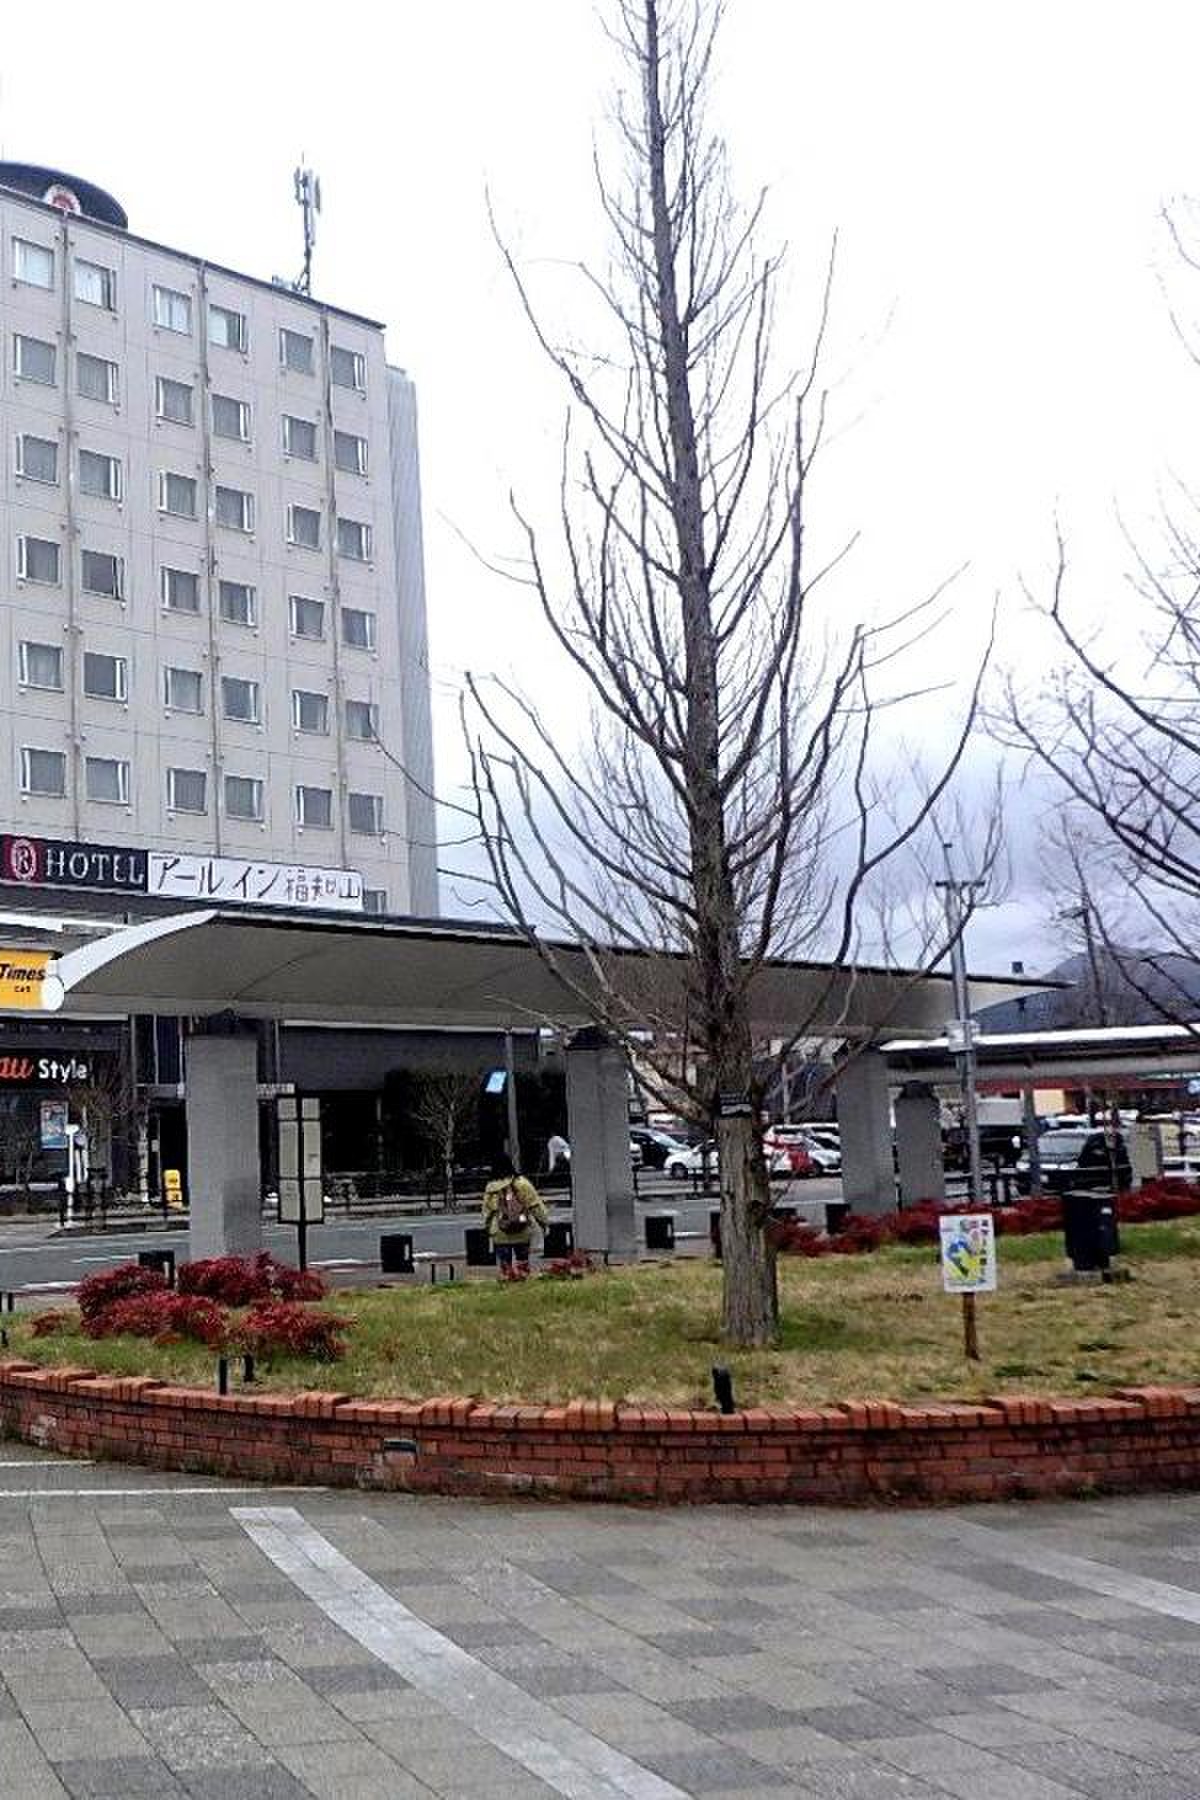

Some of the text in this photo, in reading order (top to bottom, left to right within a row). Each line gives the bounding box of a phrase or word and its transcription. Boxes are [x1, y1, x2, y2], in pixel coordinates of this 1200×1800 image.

[46, 849, 144, 884] HOTEL
[0, 962, 46, 981] Times
[38, 1058, 88, 1083] Style
